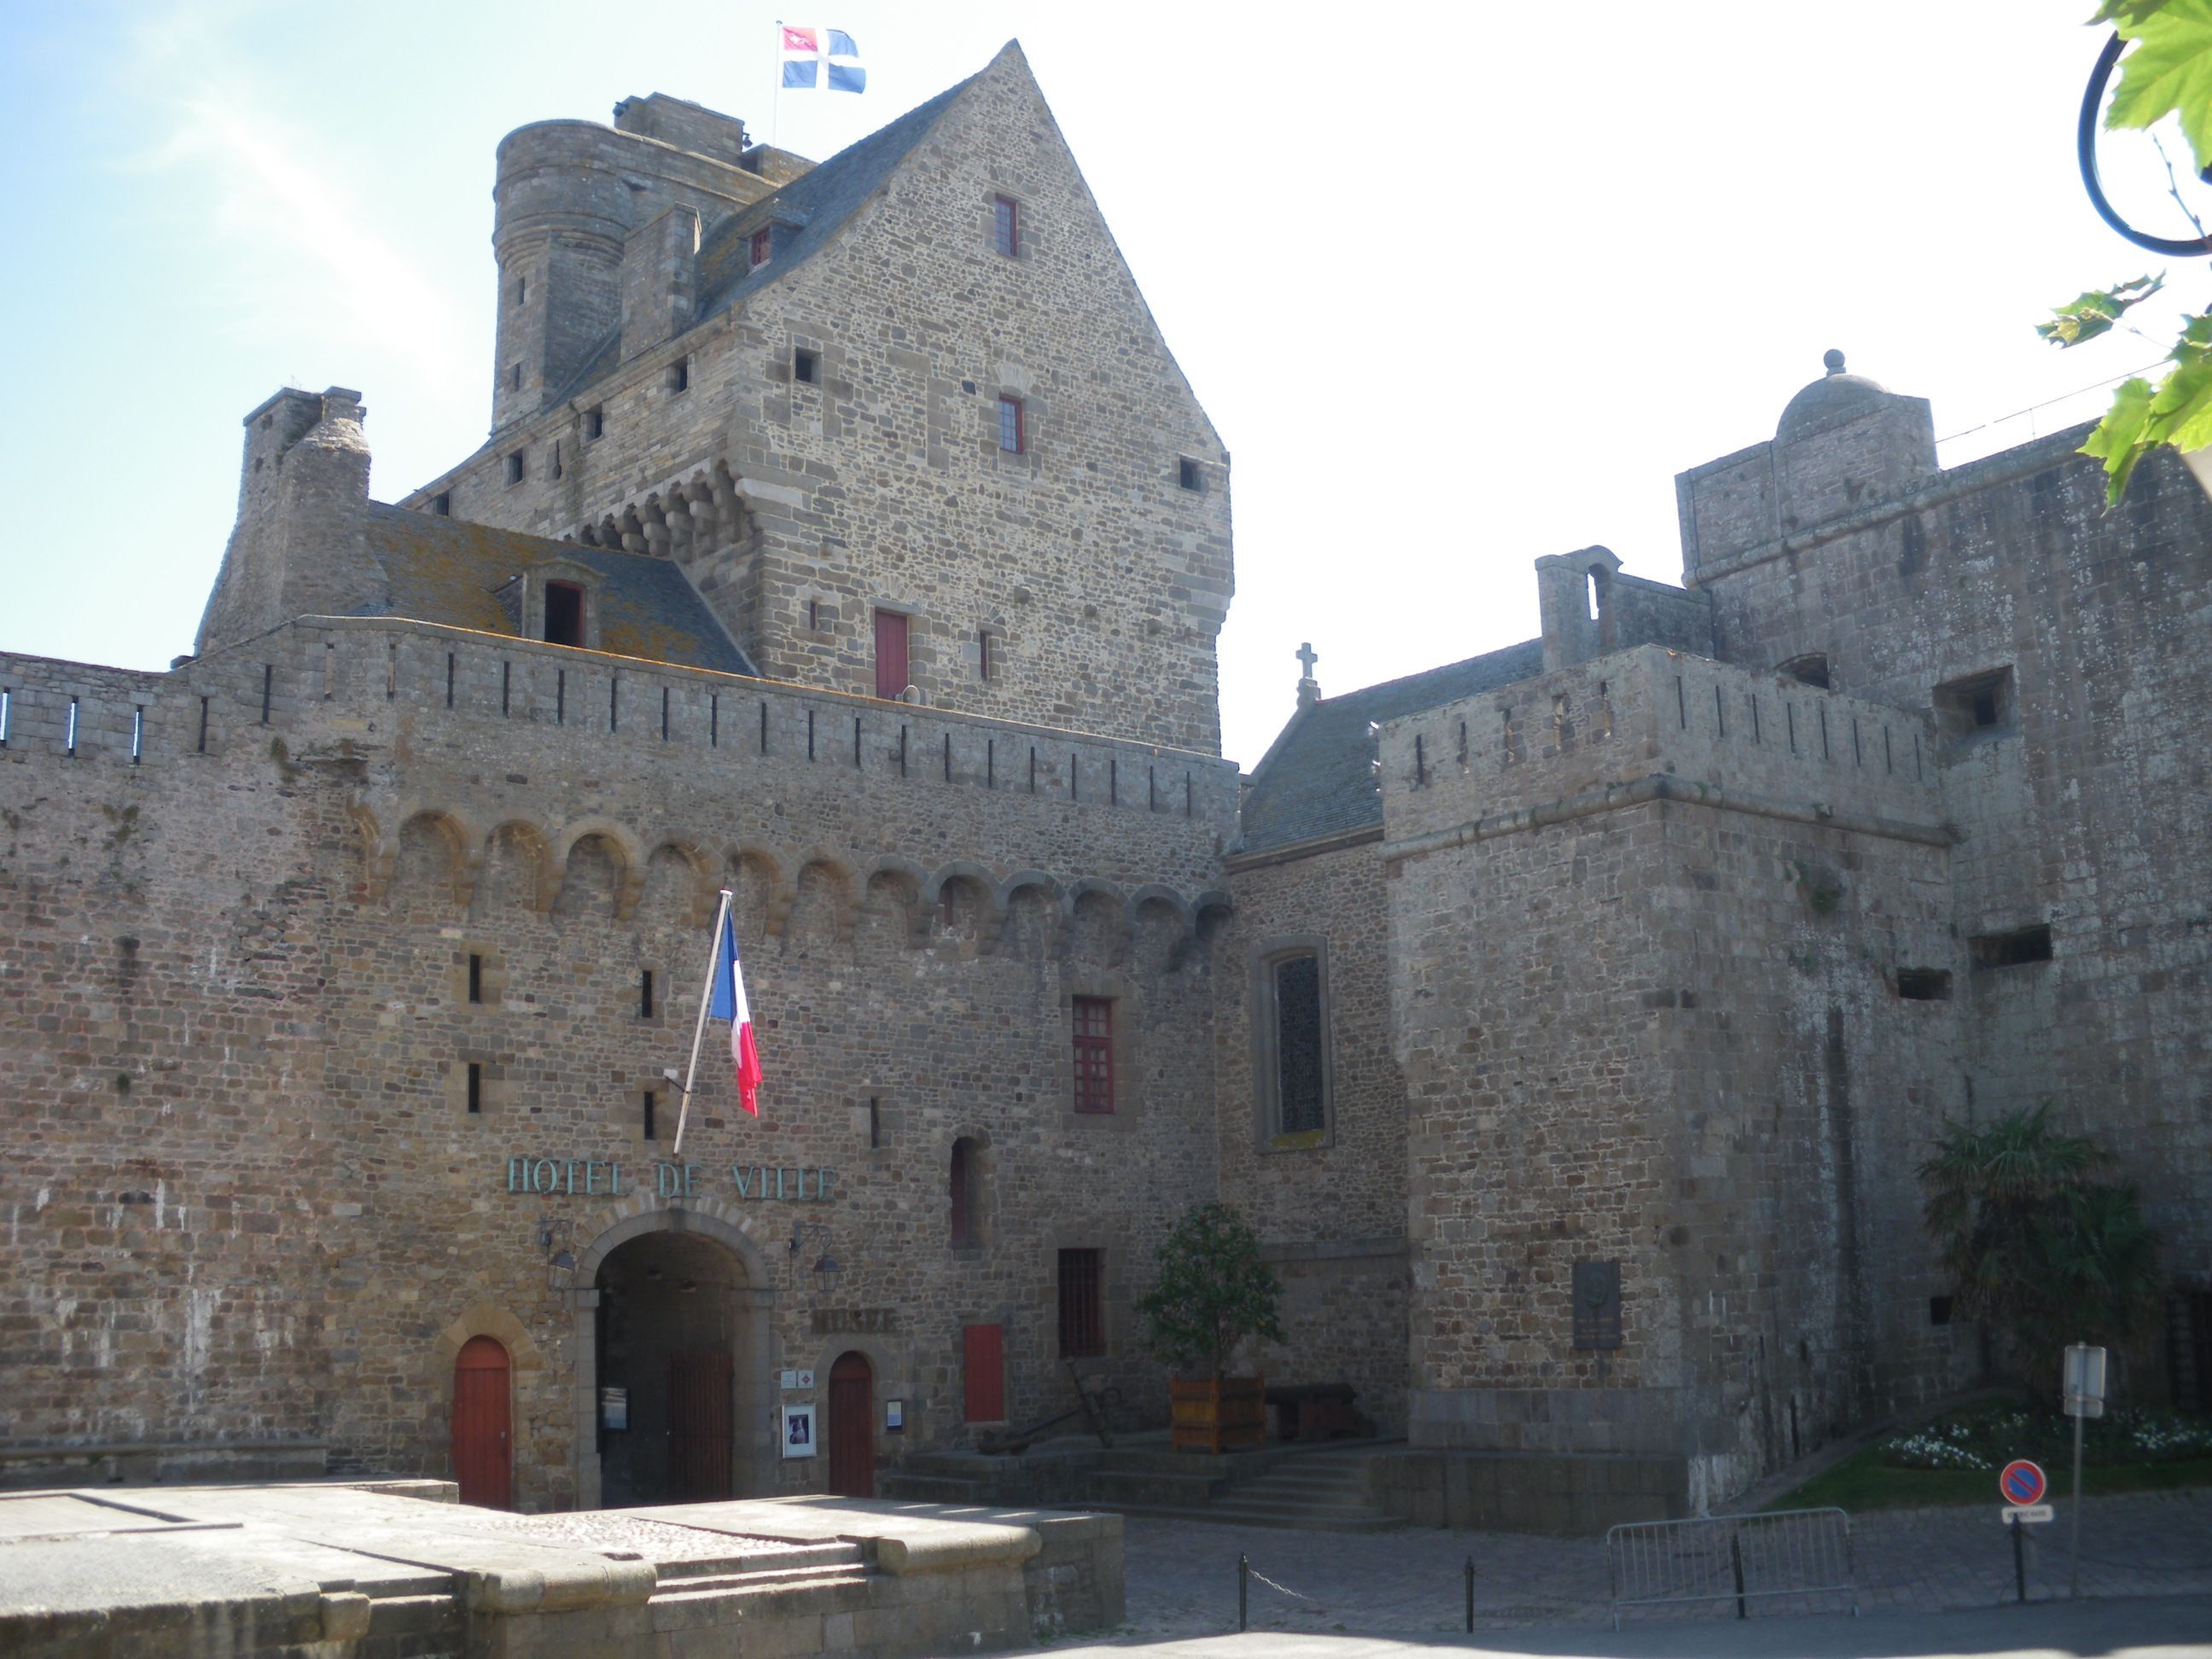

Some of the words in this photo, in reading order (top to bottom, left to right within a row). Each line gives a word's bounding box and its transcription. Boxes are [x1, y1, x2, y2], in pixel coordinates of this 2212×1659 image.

[507, 1156, 629, 1196] HOTEL
[655, 1161, 702, 1198] DE
[731, 1164, 836, 1202] VILLE
